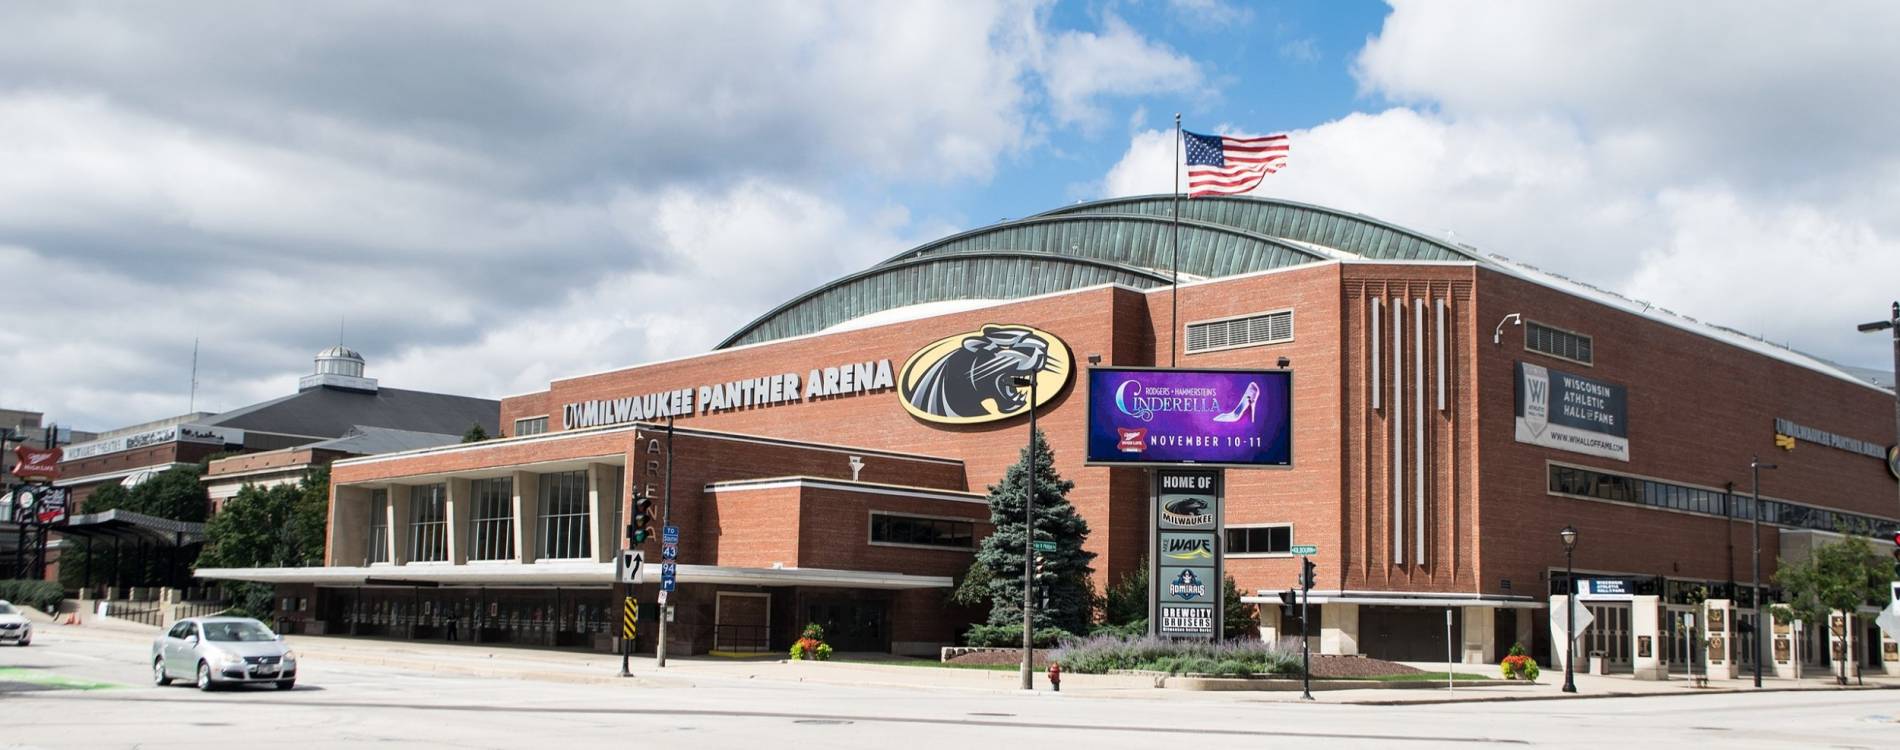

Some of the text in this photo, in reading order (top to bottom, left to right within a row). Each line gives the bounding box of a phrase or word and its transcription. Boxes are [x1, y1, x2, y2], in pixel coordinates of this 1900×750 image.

[698, 373, 800, 412] PANTHER
[806, 359, 895, 398] ARENA
[1145, 387, 1170, 395] RODGERS
[1174, 387, 1217, 396] HAMMERSTEIN'S
[1563, 376, 1611, 398] WISCONSIN
[1115, 379, 1221, 422] CINDERELLA
[1563, 391, 1605, 410] ATHLETIC
[1563, 405, 1587, 419] HALL
[1594, 411, 1614, 426] FAME
[1151, 435, 1219, 447] NOVEMBER
[1227, 437, 1261, 447] 10-11
[1163, 476, 1211, 488] HOME OF
[1162, 513, 1212, 526] MILWAUKEE
[1169, 539, 1211, 552] WAVE
[664, 547, 676, 557] 43
[663, 564, 674, 573] 94
[1170, 584, 1205, 595] ADMIRALS
[1164, 618, 1210, 627] BRUISERS
